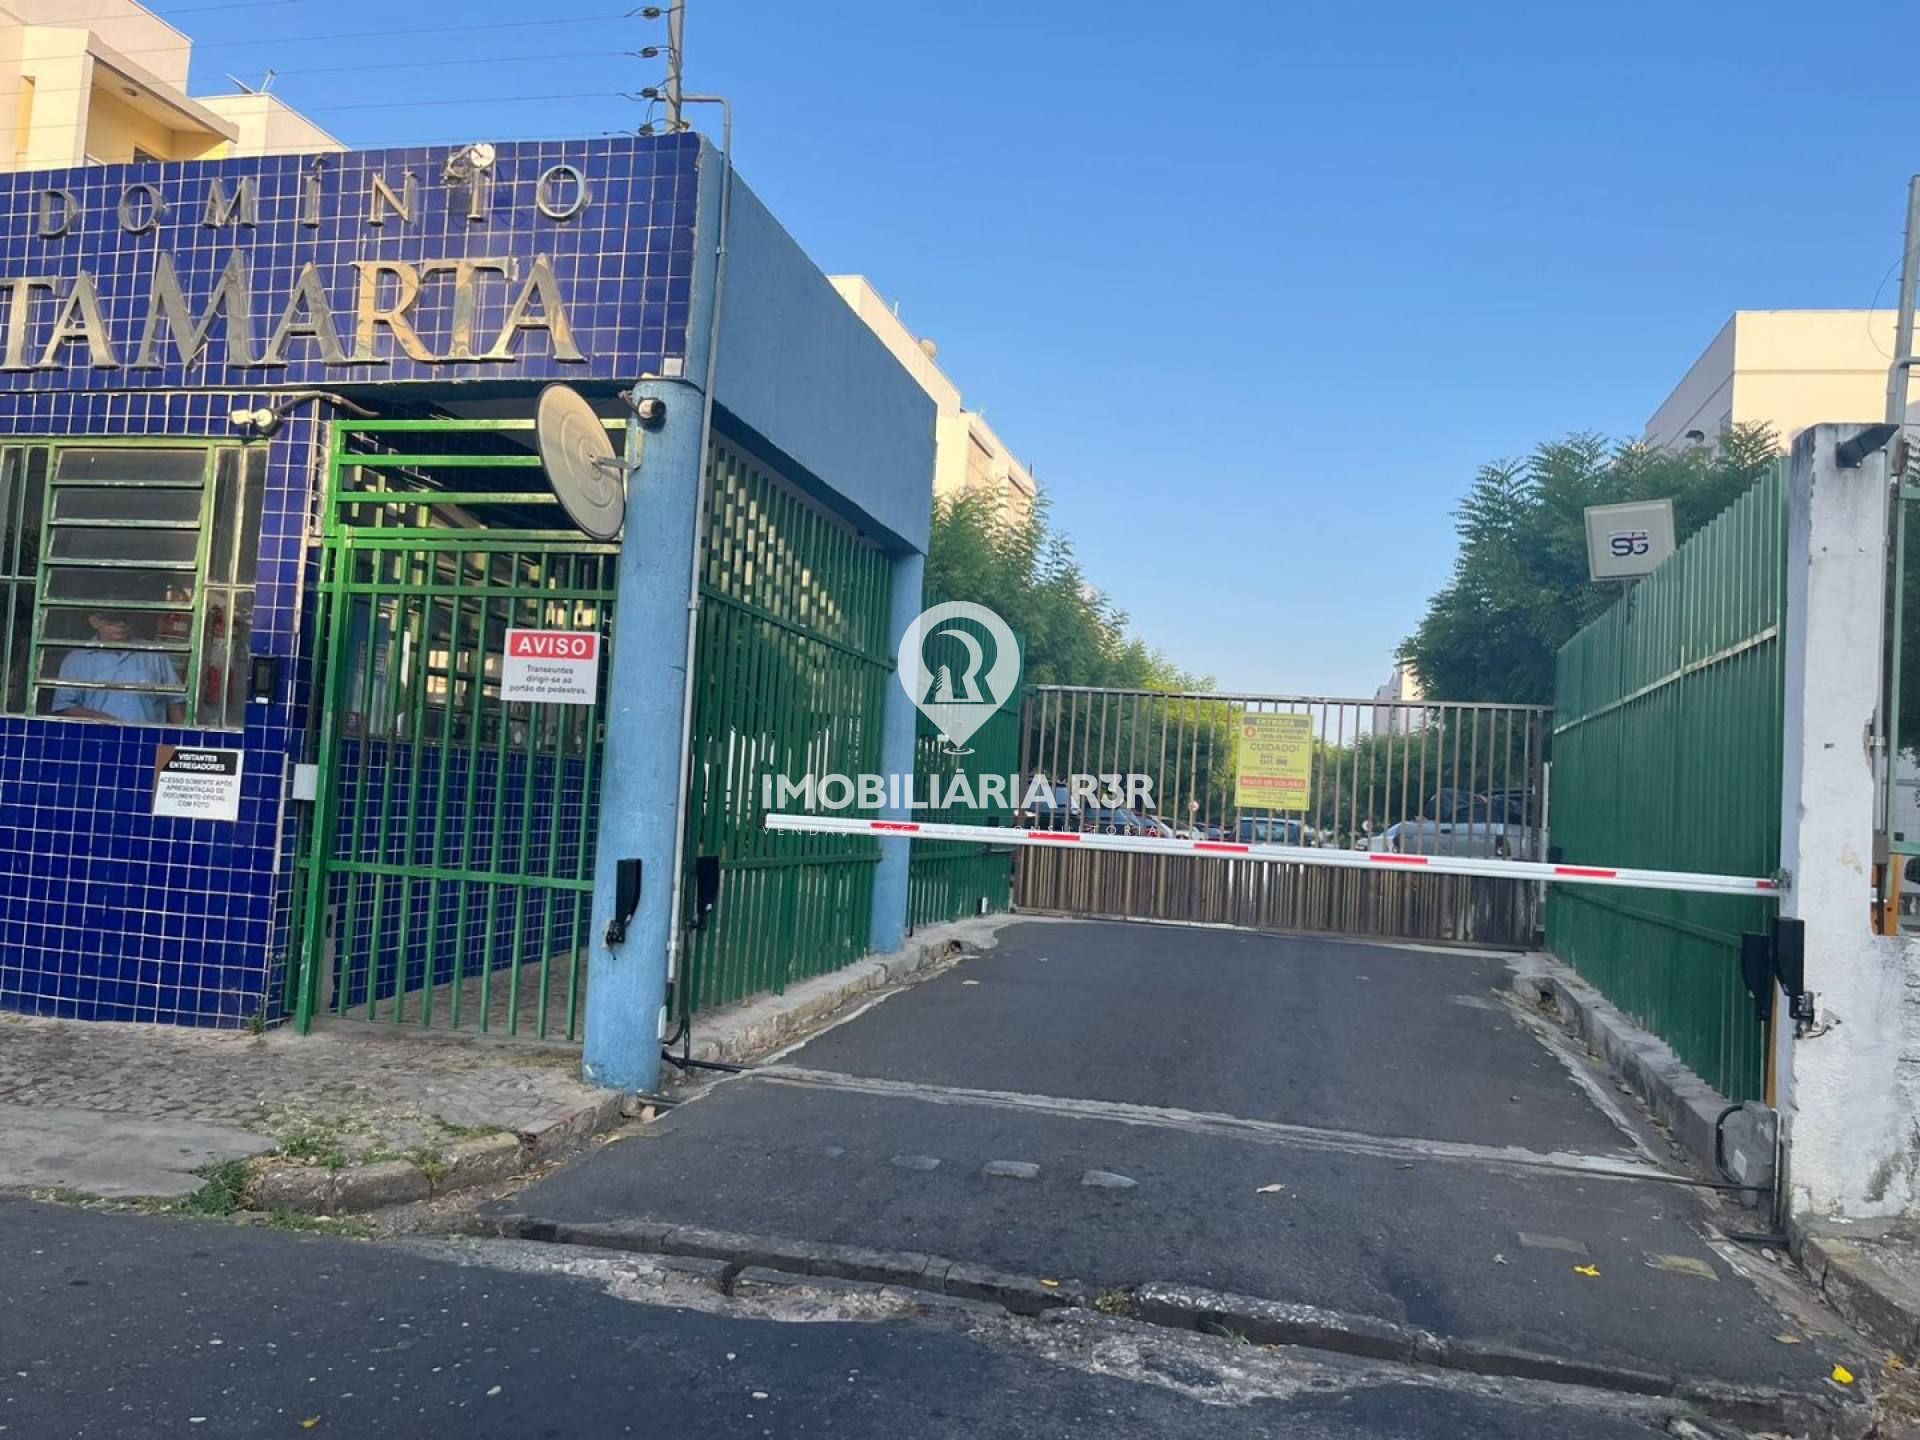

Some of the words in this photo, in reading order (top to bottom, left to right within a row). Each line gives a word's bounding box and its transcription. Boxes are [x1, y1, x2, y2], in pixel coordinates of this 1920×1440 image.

[517, 636, 587, 656] AVISO
[527, 664, 574, 675] Transeuntes
[526, 674, 560, 684] dirigir-se
[509, 683, 535, 693] portão
[536, 684, 546, 693] de
[178, 752, 218, 763] VISITANTES
[169, 761, 226, 772] ENTREGADORES
[160, 776, 185, 784] ACESSO
[185, 777, 215, 786] SOMENTE
[166, 784, 215, 794] APRESENTAÇÃO
[163, 792, 202, 801] DOCUMENTO
[177, 800, 192, 808] COM
[193, 801, 210, 809] FOTO
